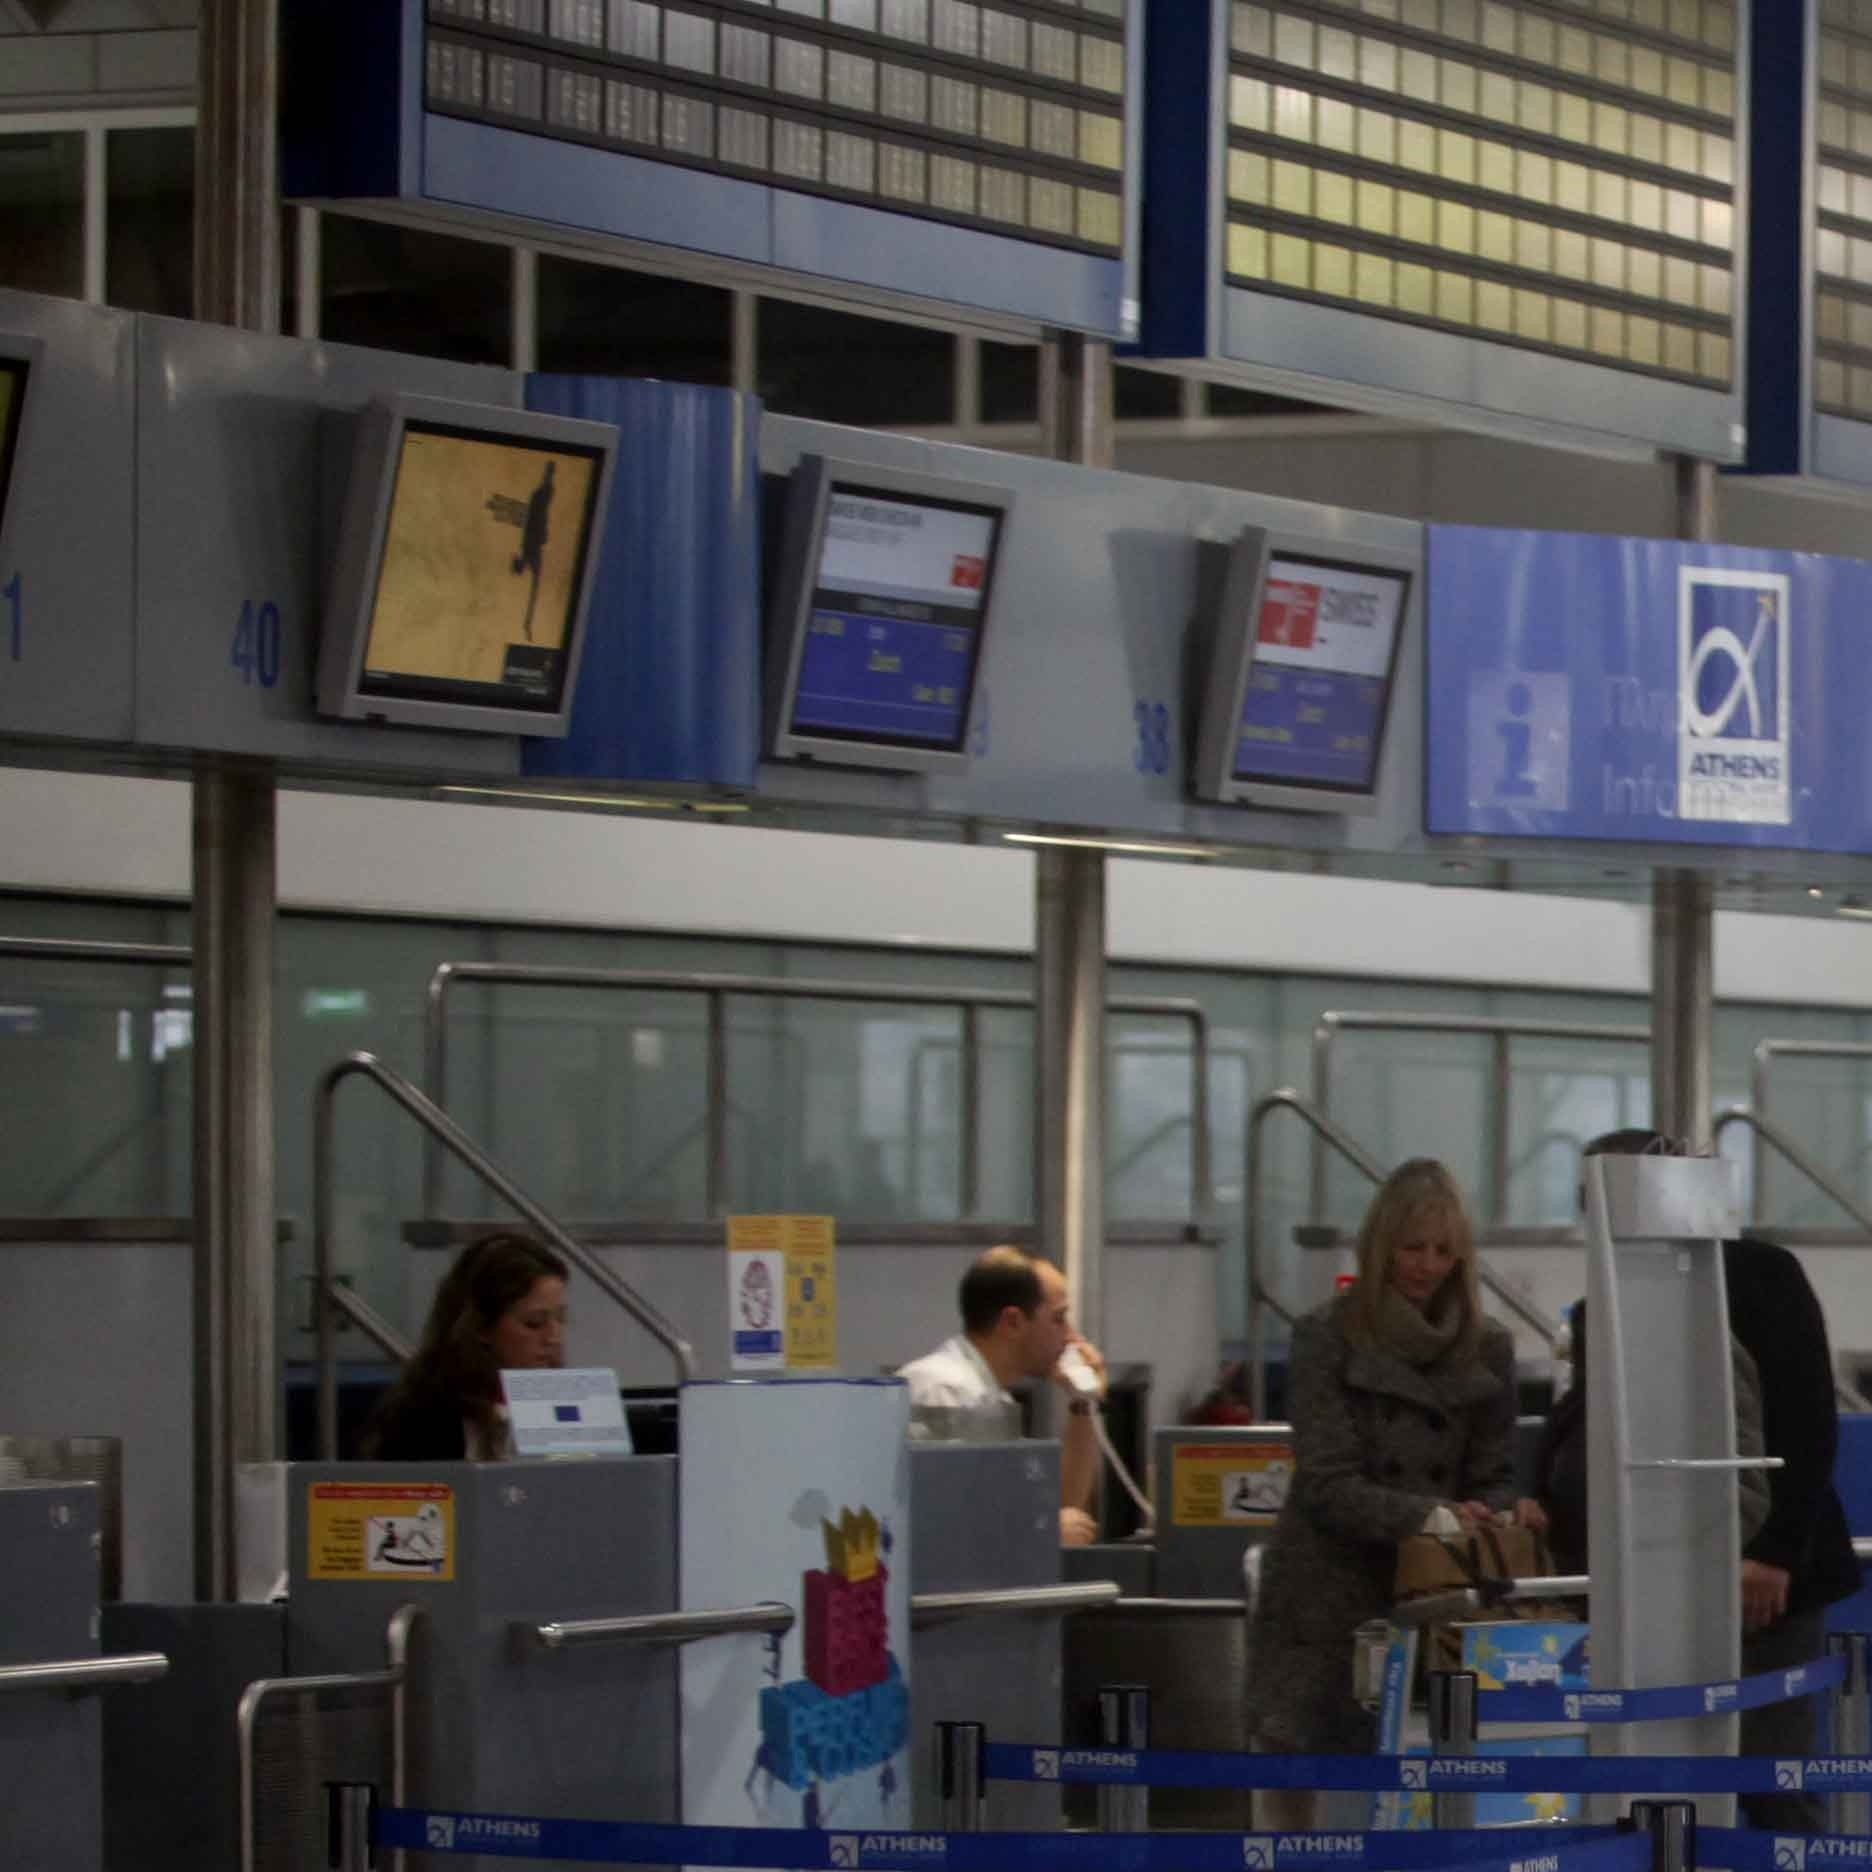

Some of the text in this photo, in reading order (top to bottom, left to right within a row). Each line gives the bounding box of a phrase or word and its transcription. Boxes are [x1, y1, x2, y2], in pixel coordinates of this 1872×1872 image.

[231, 599, 280, 688] 40
[1689, 751, 1780, 781] ATHENS
[1062, 1752, 1137, 1768] ATHENS
[1430, 1761, 1506, 1774] ATHENS
[458, 1818, 540, 1837] ATHENS
[861, 1835, 946, 1852] ATHENS
[1278, 1836, 1364, 1852] ATHENS
